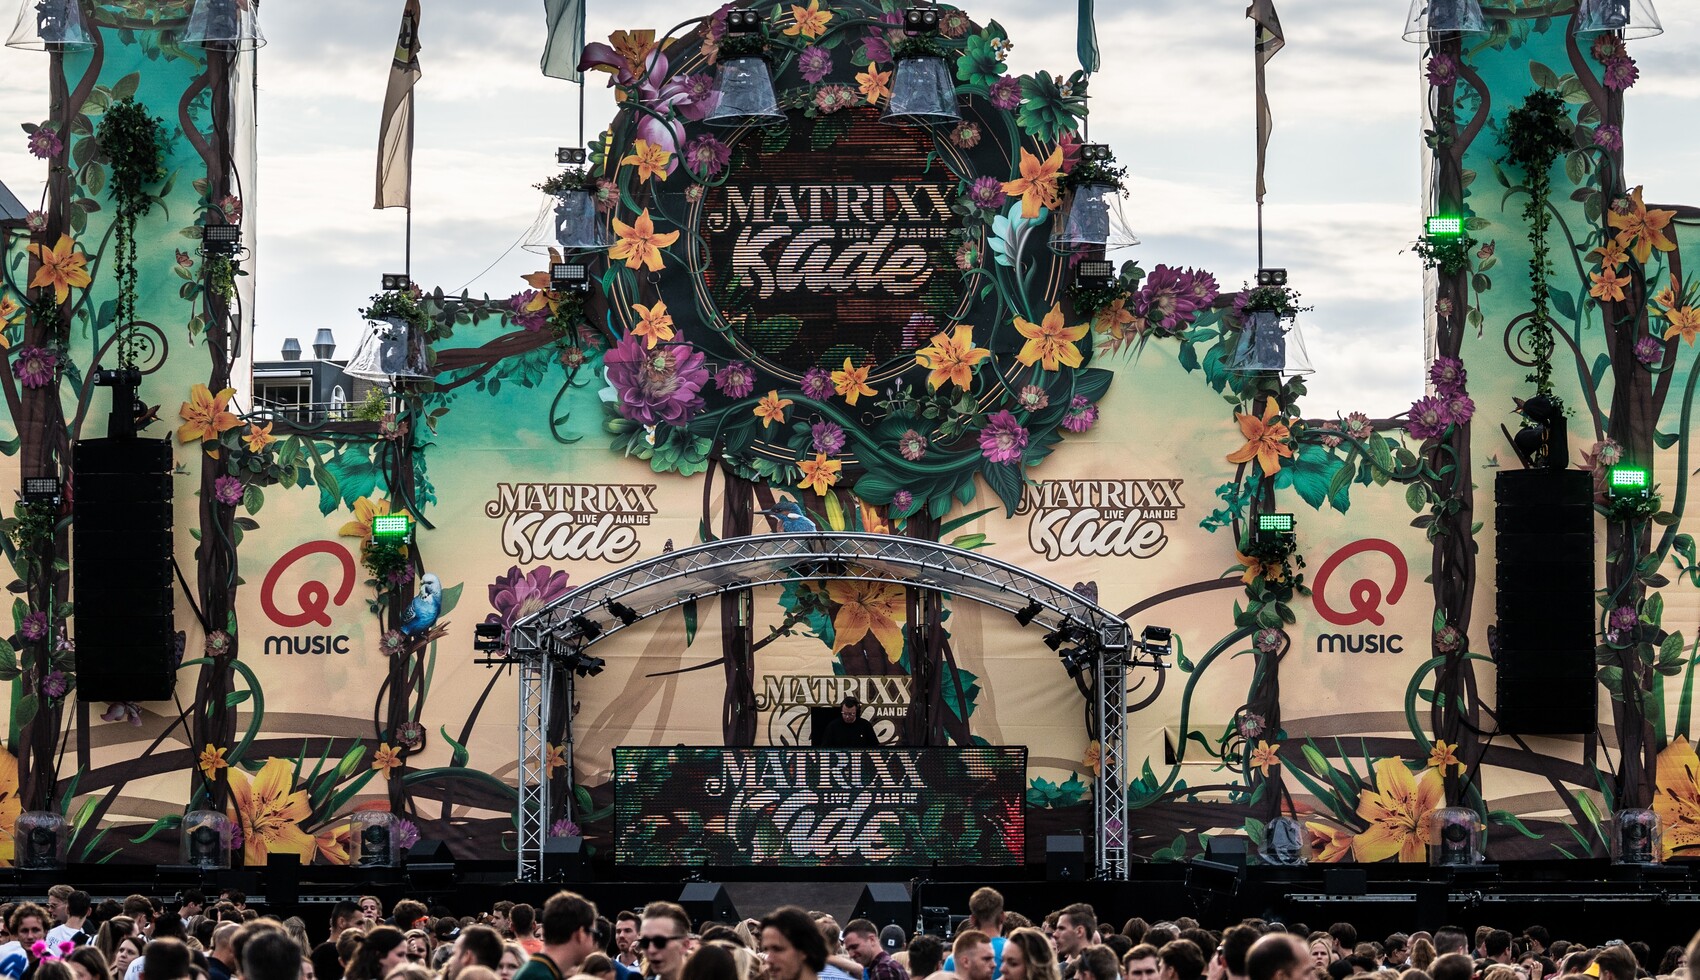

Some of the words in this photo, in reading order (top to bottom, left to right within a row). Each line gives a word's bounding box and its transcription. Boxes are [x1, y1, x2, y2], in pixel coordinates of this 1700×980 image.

[706, 184, 956, 232] MATRIXX
[732, 224, 934, 299] Kade
[485, 483, 658, 518] MATRIXX
[577, 514, 597, 524] LIVE
[615, 514, 635, 524] AAN
[636, 514, 649, 524] DE
[1014, 479, 1186, 515] MATRIXX
[1104, 509, 1124, 519] LIVE
[1142, 509, 1163, 519] AAN
[1164, 509, 1176, 519] DE
[502, 512, 641, 565] Kade
[1029, 508, 1168, 561] Kade
[260, 540, 356, 627] Q
[1312, 538, 1408, 626] Q
[755, 675, 912, 711] MATRIXX
[876, 707, 895, 716] AAN
[896, 707, 908, 716] DE
[705, 751, 928, 796] MATRIXX
